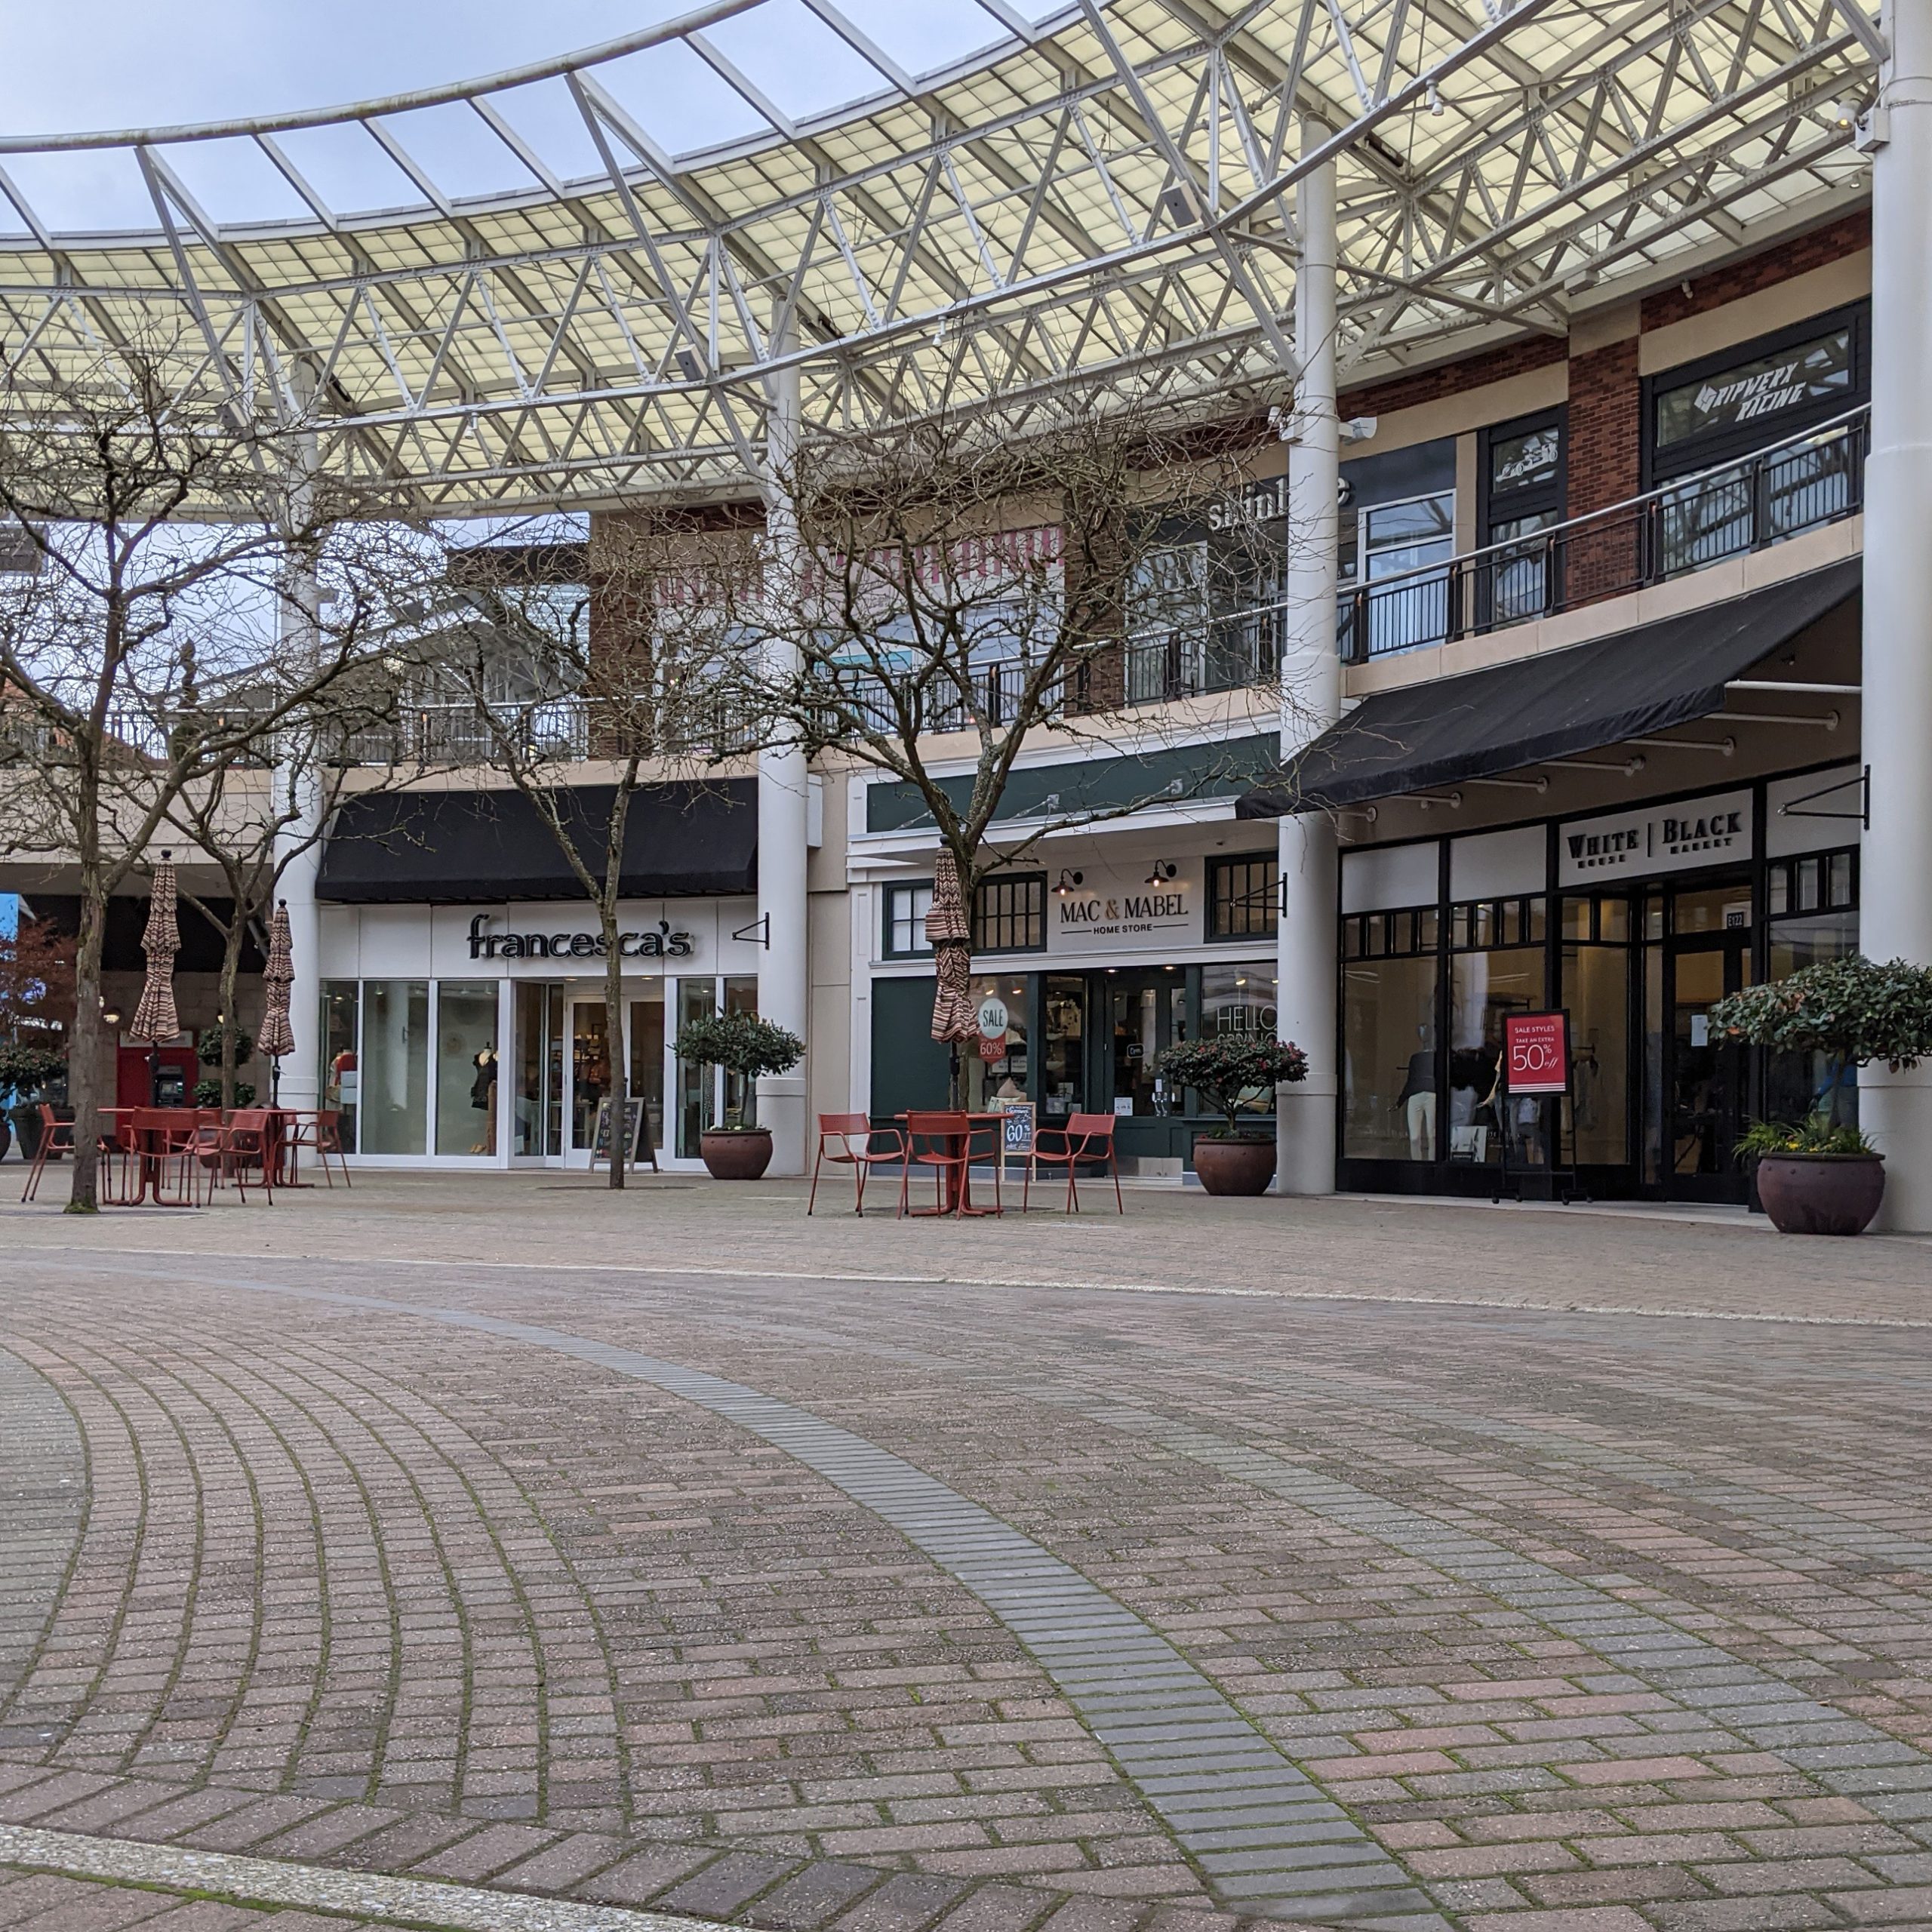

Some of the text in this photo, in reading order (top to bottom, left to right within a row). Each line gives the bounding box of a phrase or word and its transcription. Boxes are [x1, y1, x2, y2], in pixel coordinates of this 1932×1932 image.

[1734, 381, 1807, 423] RACING
[1662, 812, 1743, 844] BLACK
[1567, 829, 1639, 859] WHITE
[1060, 894, 1189, 923] MAC & MABEL
[1094, 923, 1153, 934] HOME STORE
[1727, 914, 1743, 927] E122
[983, 1009, 1004, 1027] SALE
[1217, 1004, 1278, 1032] HELLO
[1531, 1025, 1555, 1033] STYLES
[980, 1041, 1002, 1055] 60%
